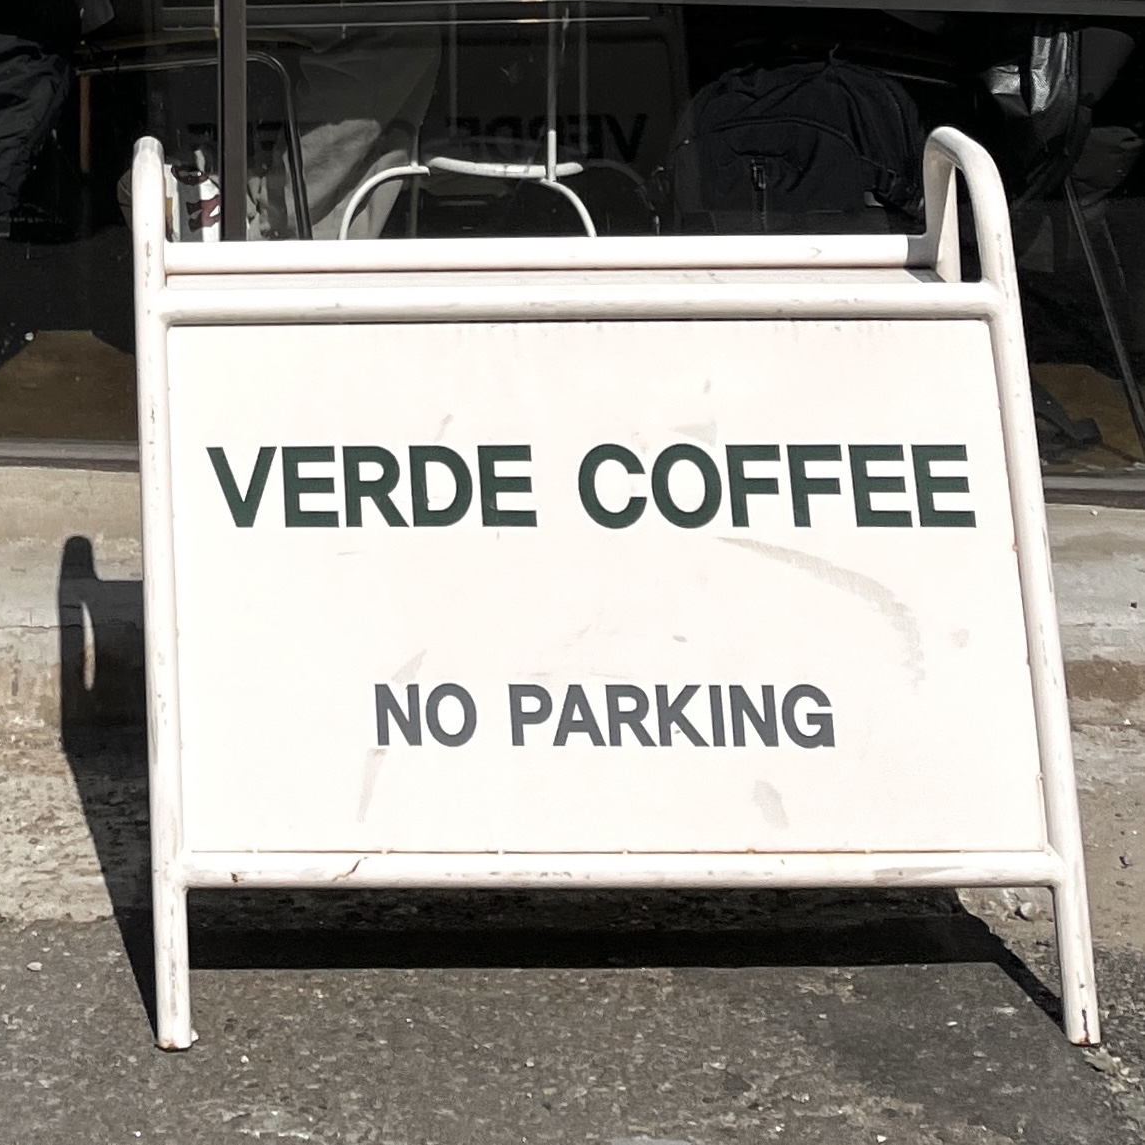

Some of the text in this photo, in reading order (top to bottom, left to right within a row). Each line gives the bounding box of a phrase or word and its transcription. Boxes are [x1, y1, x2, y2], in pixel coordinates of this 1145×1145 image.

[206, 443, 977, 529] VERDE COFFEE
[374, 682, 836, 748] NO PARKING
